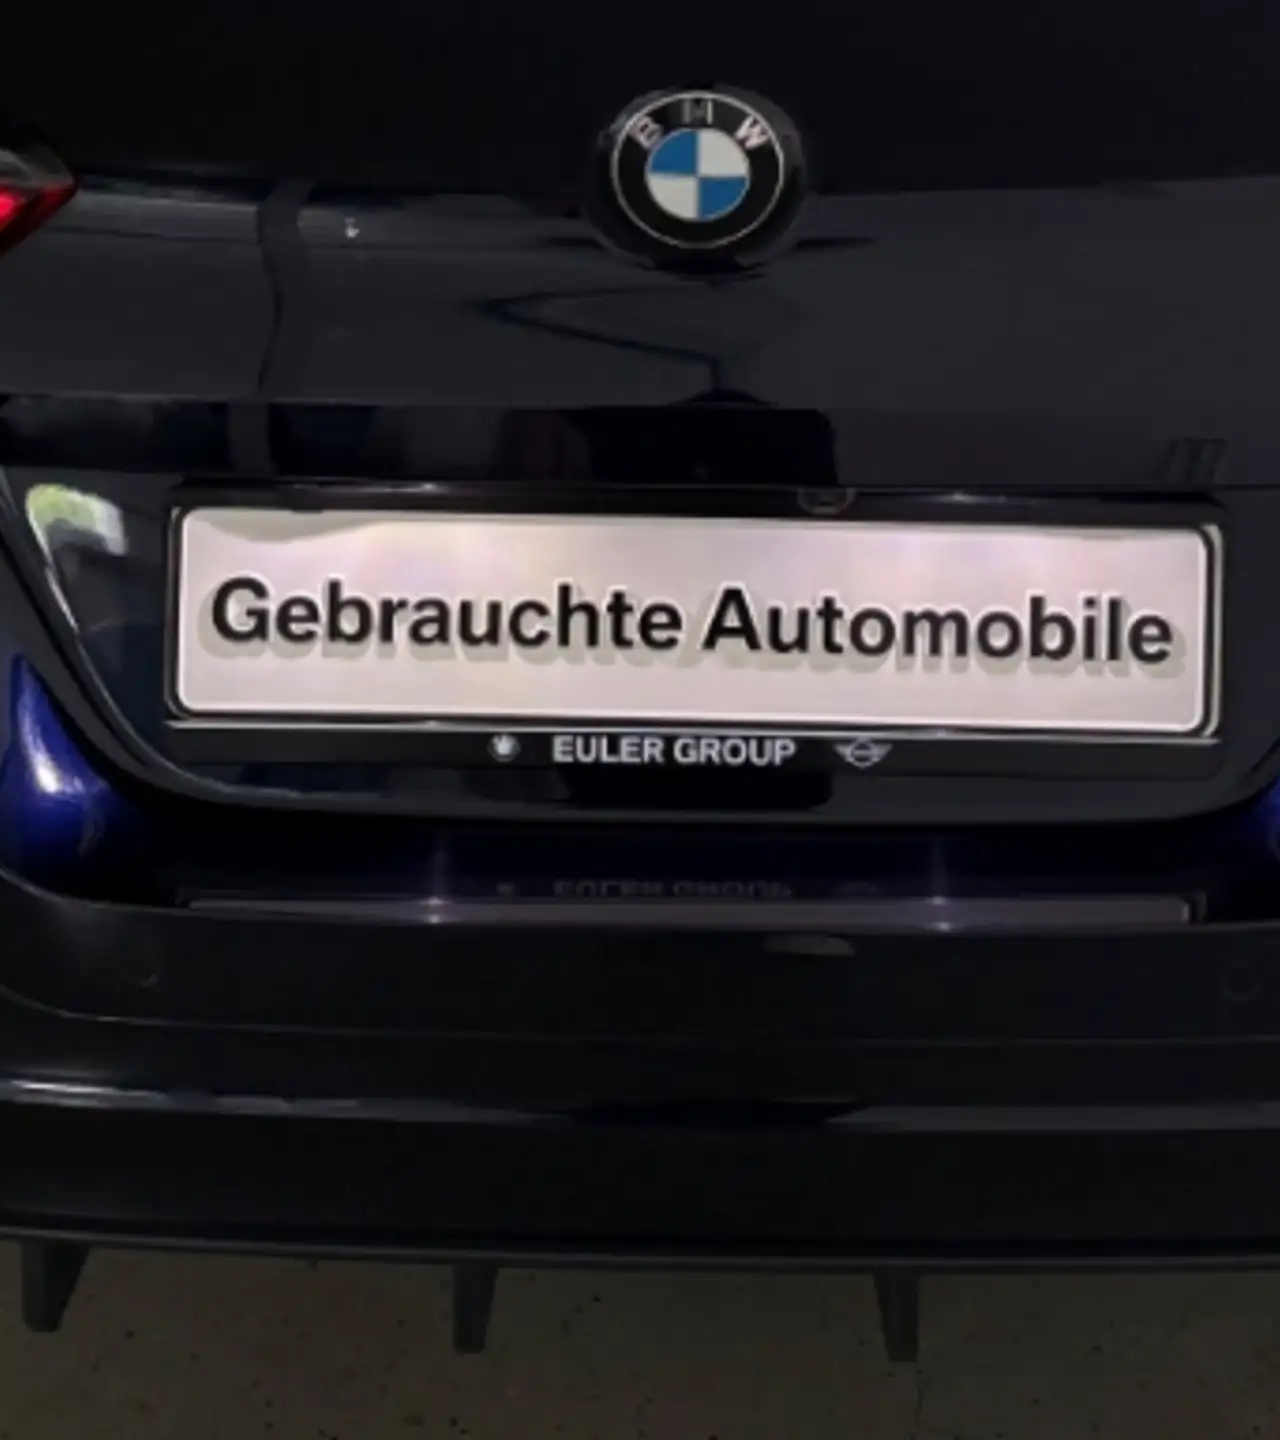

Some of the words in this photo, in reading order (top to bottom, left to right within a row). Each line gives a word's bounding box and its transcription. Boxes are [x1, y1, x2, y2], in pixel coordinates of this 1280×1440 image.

[628, 99, 771, 150] BMW
[211, 576, 682, 650] Gebrauchte
[702, 586, 1172, 664] Automobile
[552, 734, 664, 763] EULER
[673, 737, 796, 766] GROUP
